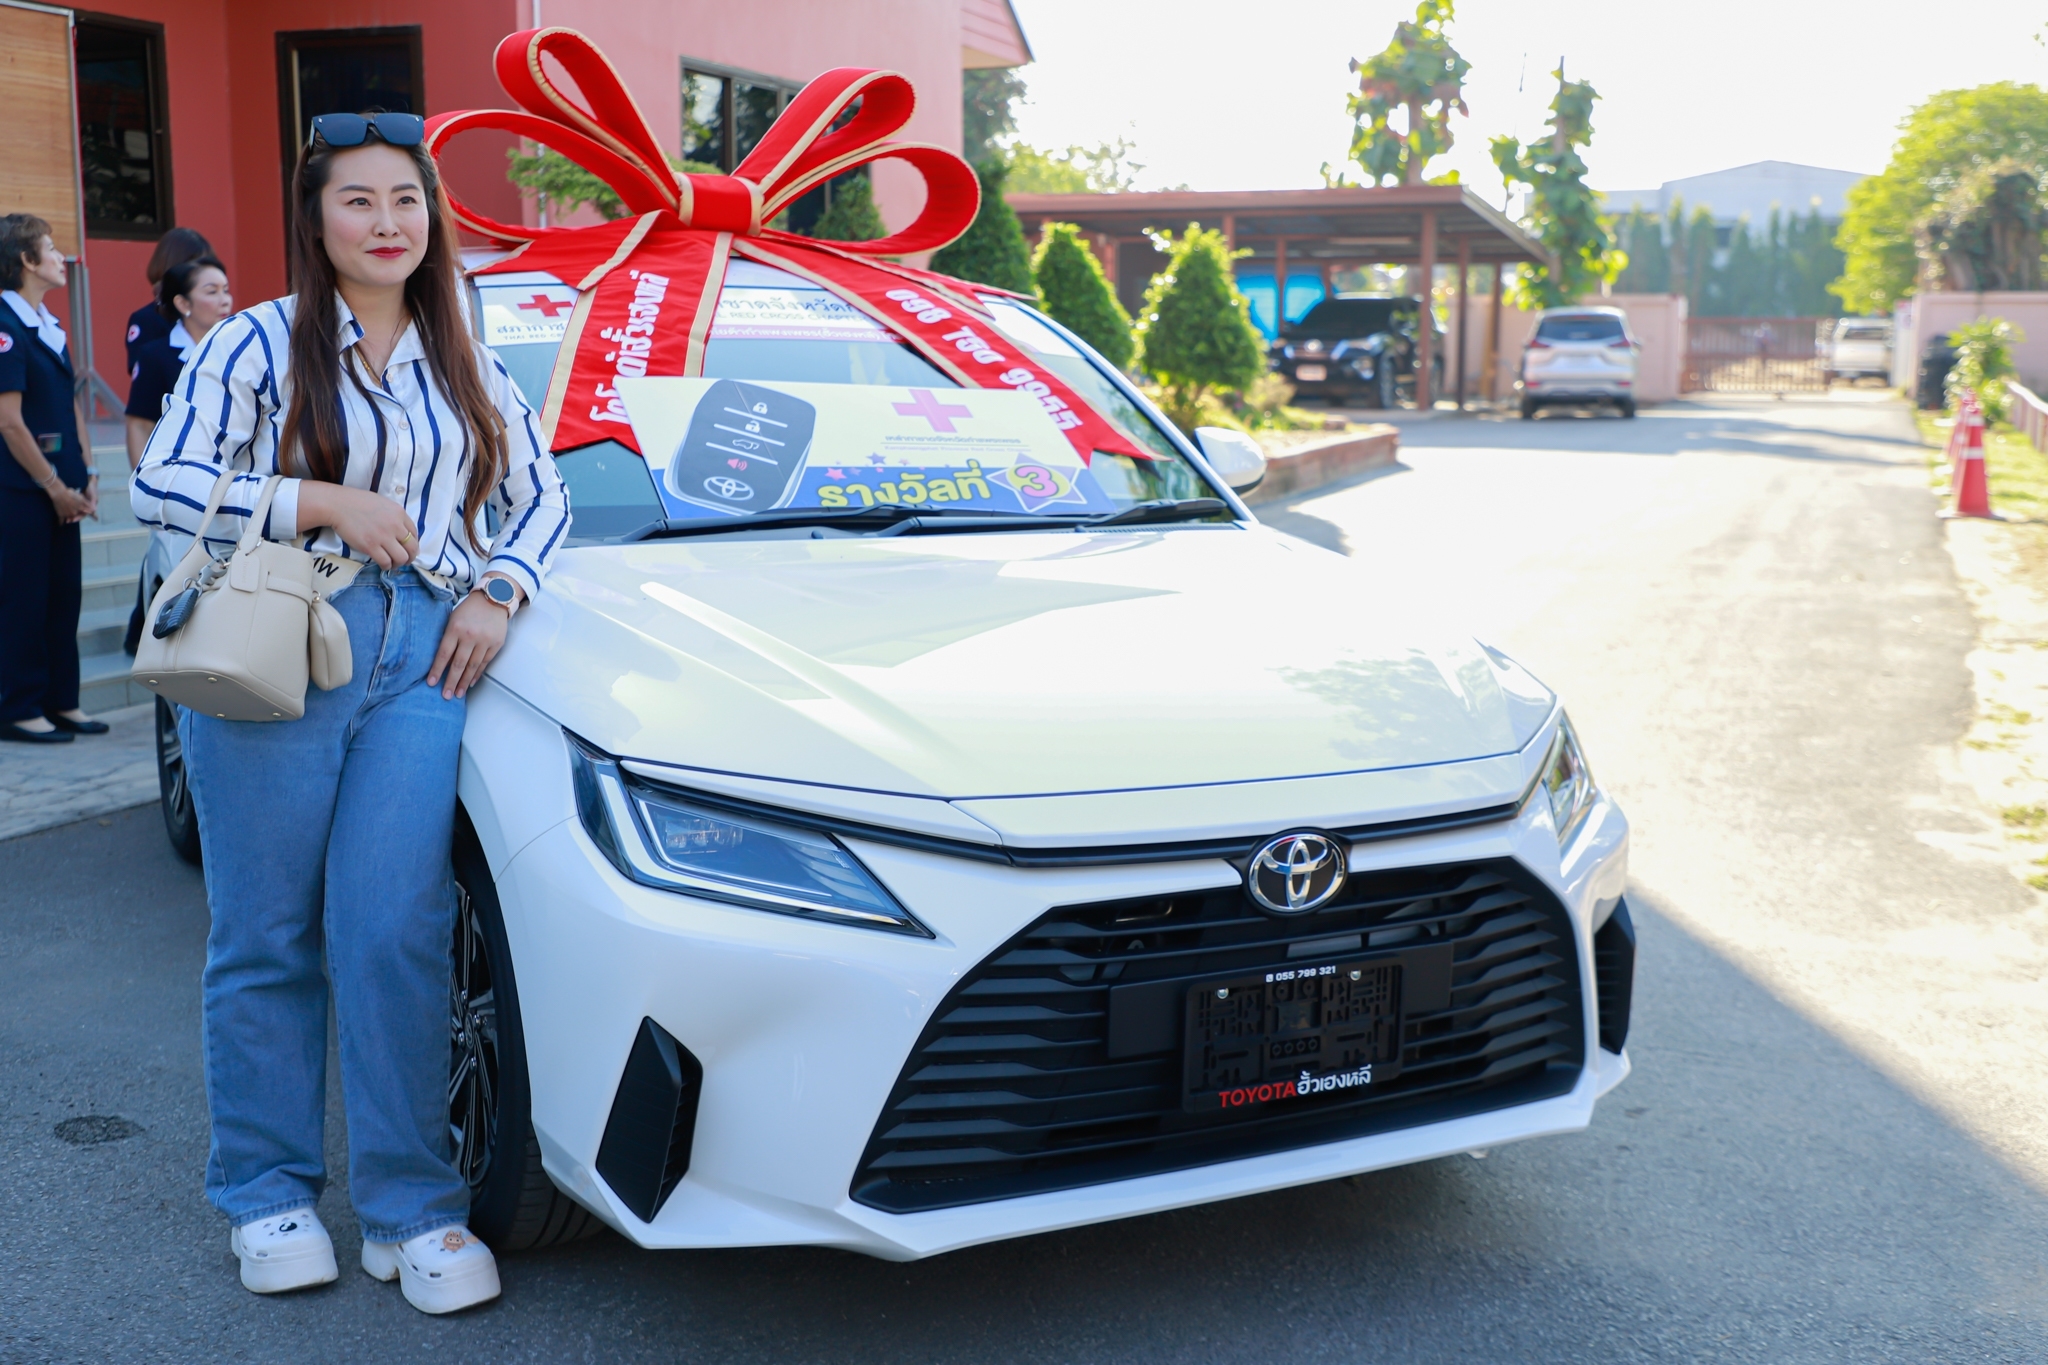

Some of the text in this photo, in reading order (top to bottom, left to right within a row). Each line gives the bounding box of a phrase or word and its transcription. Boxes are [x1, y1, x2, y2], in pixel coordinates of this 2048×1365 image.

[497, 322, 565, 334] สภากาช
[885, 288, 952, 324] 098
[942, 325, 1006, 364] 750
[817, 458, 1059, 508] รางวัลที่ 3
[1275, 965, 1336, 982] 055 799 321
[1218, 1064, 1372, 1108] TOYOTA ฮั้วเฮงหลี
